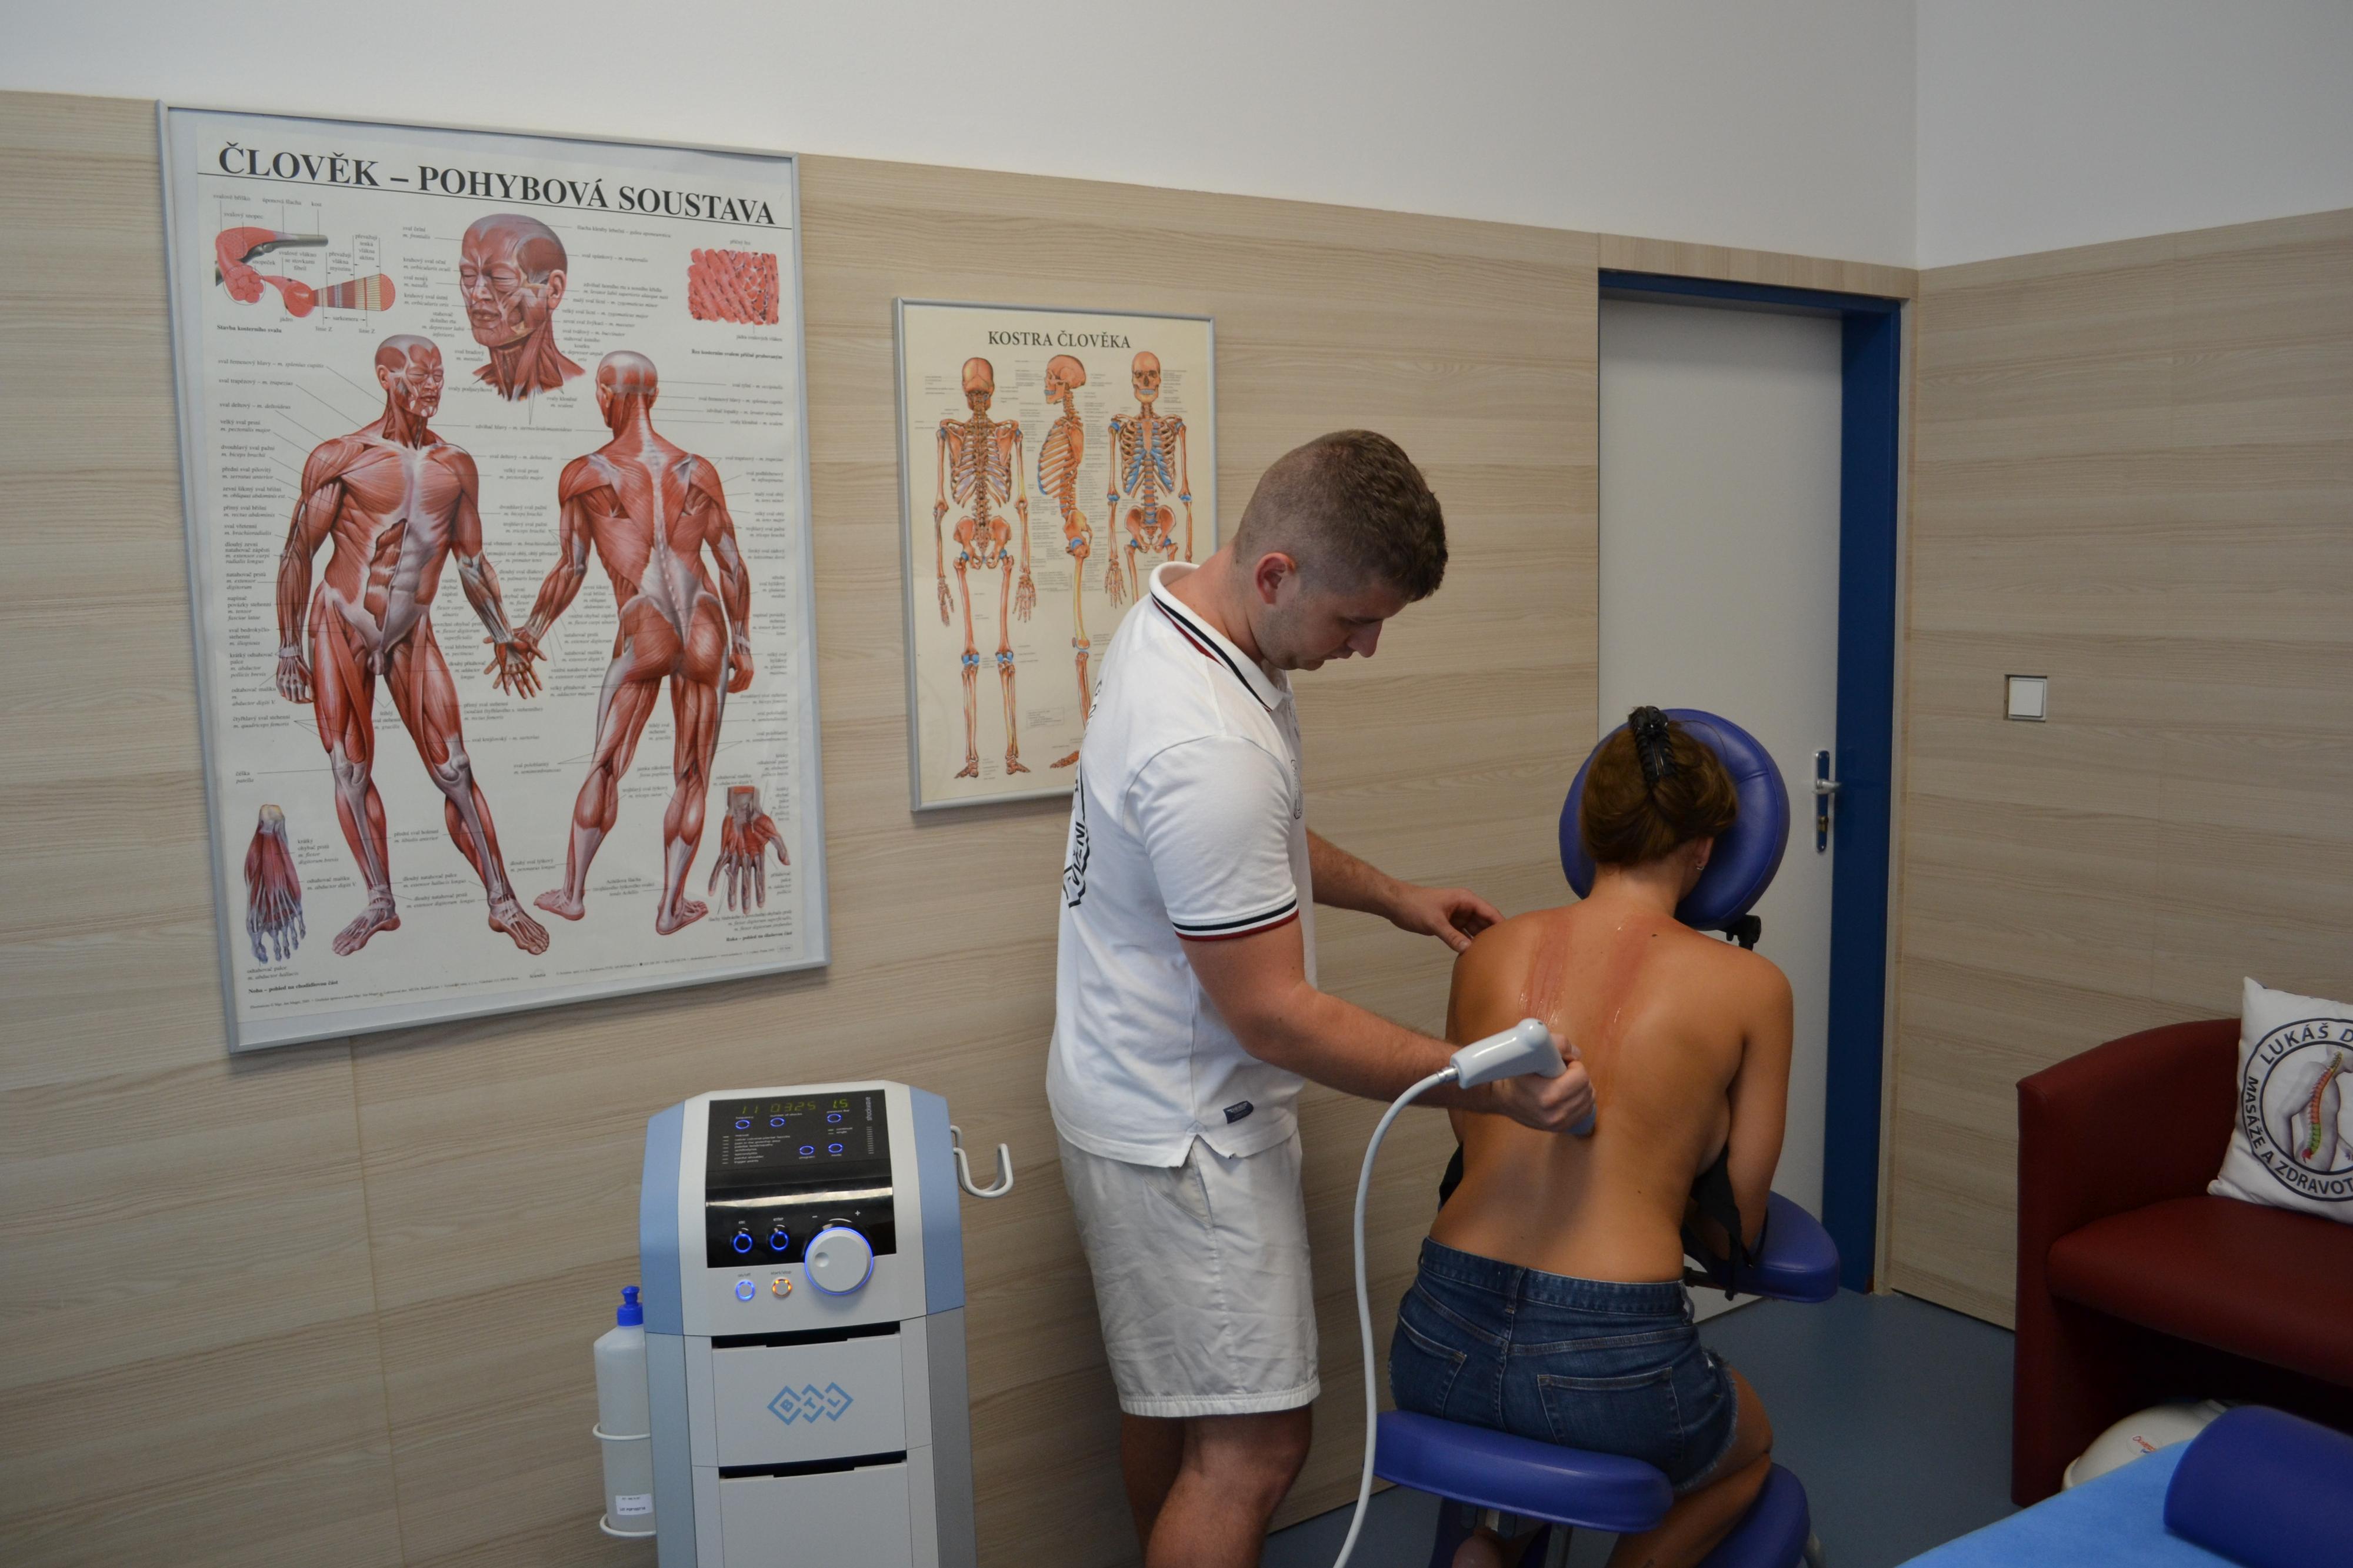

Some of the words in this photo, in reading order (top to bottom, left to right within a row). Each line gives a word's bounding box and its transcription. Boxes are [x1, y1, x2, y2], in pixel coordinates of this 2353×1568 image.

[219, 141, 380, 186] ČLOVĚK
[418, 165, 609, 208] POHYBOVÁ
[619, 185, 775, 225] SOUSTAVA
[988, 331, 1052, 347] KOSTRA
[1058, 329, 1131, 349] ČLOVĚKA
[2260, 1023, 2328, 1065] LUKÁŠ
[2245, 1076, 2265, 1149] MASÁŽE
